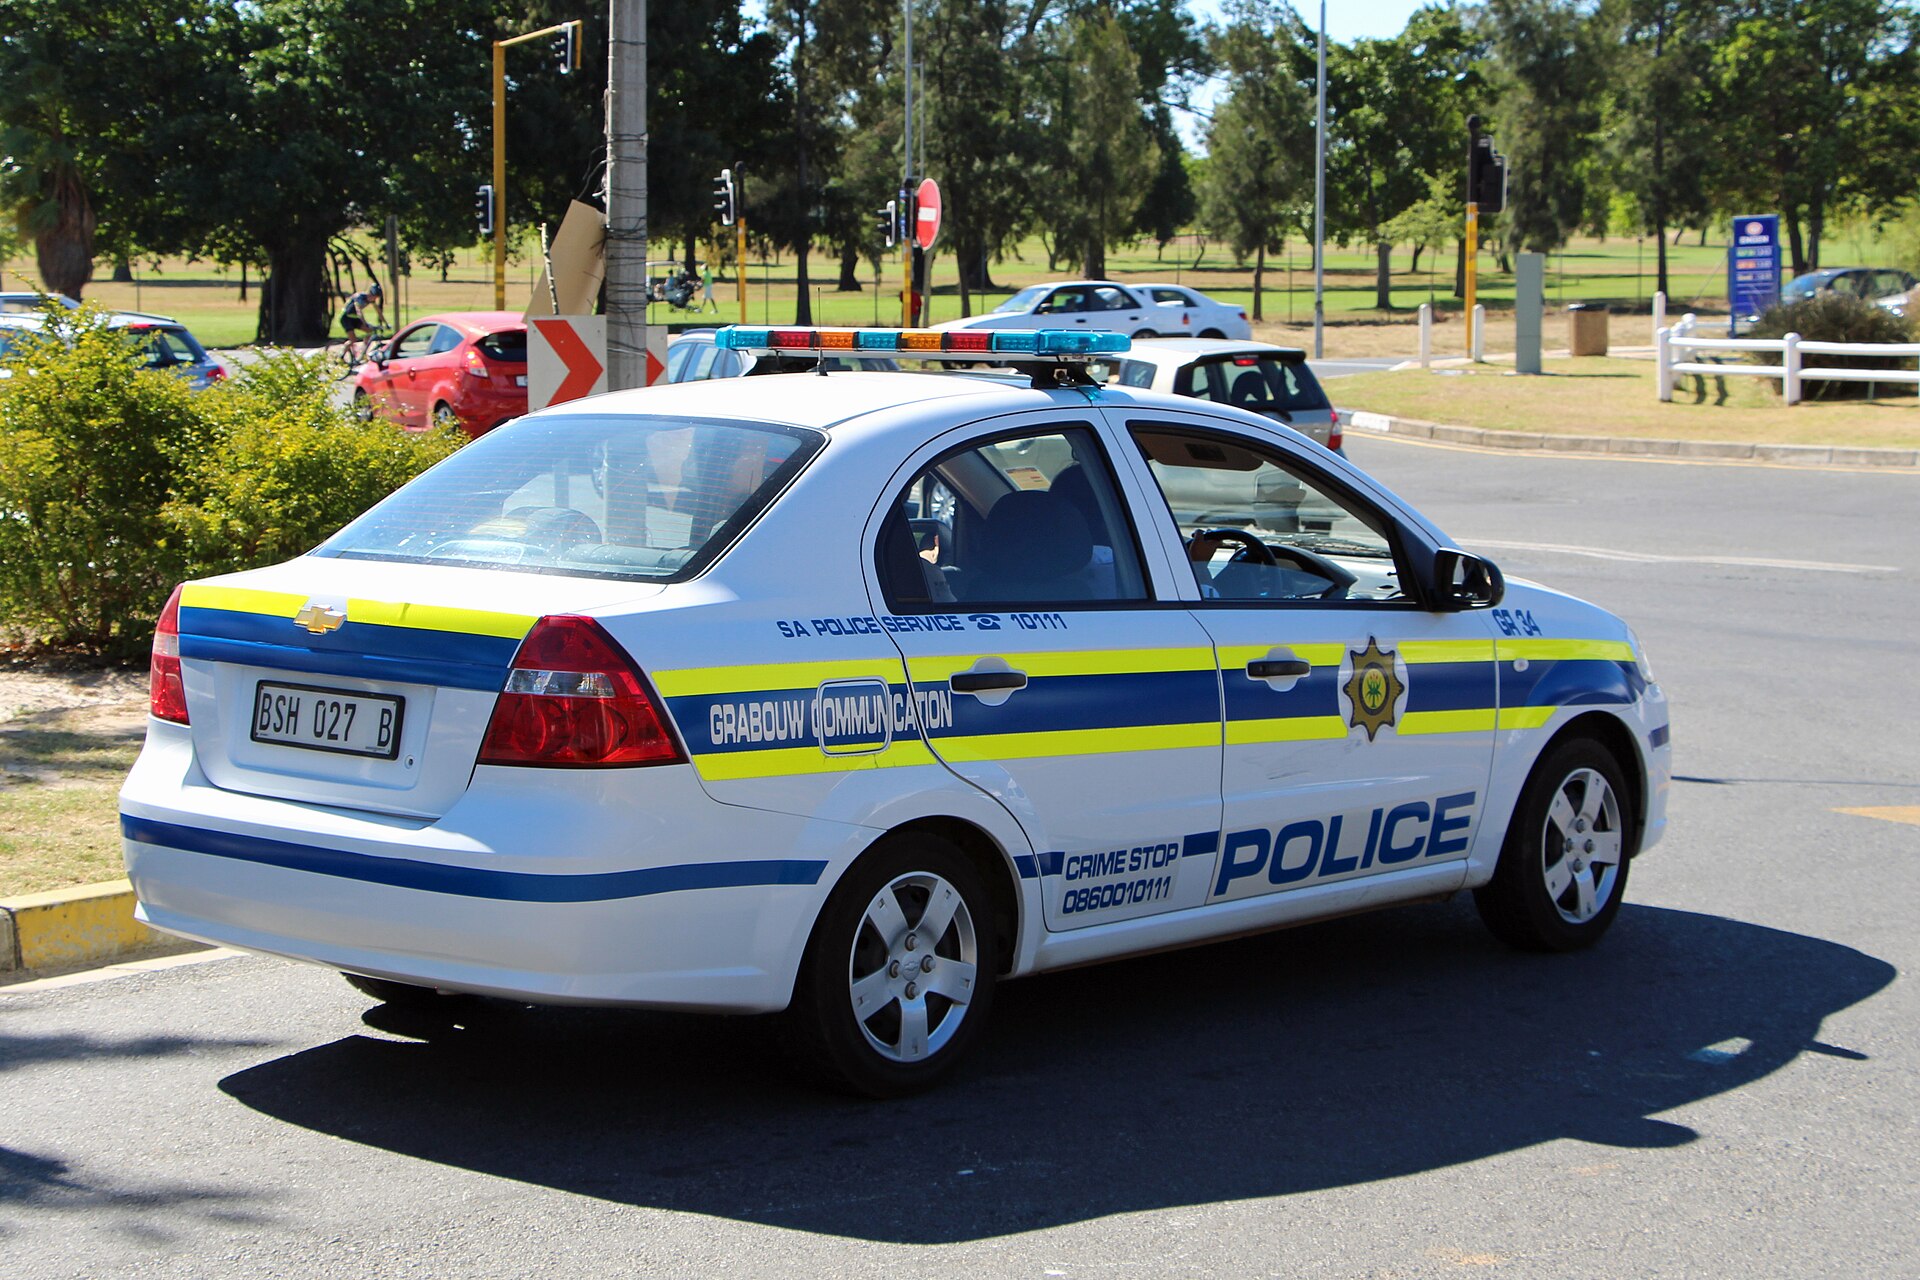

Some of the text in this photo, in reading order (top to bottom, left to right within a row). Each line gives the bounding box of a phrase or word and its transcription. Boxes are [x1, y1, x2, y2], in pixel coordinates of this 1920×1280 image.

[776, 613, 1068, 638] SA POLICE SERVICE 10111
[1492, 609, 1543, 636] GR 34
[259, 693, 392, 747] BSH 027 B
[709, 699, 805, 745] GRABOUW
[1065, 843, 1179, 882] CRIME STOP
[1213, 791, 1476, 897] POLICE
[1062, 876, 1172, 915] 0860010111
